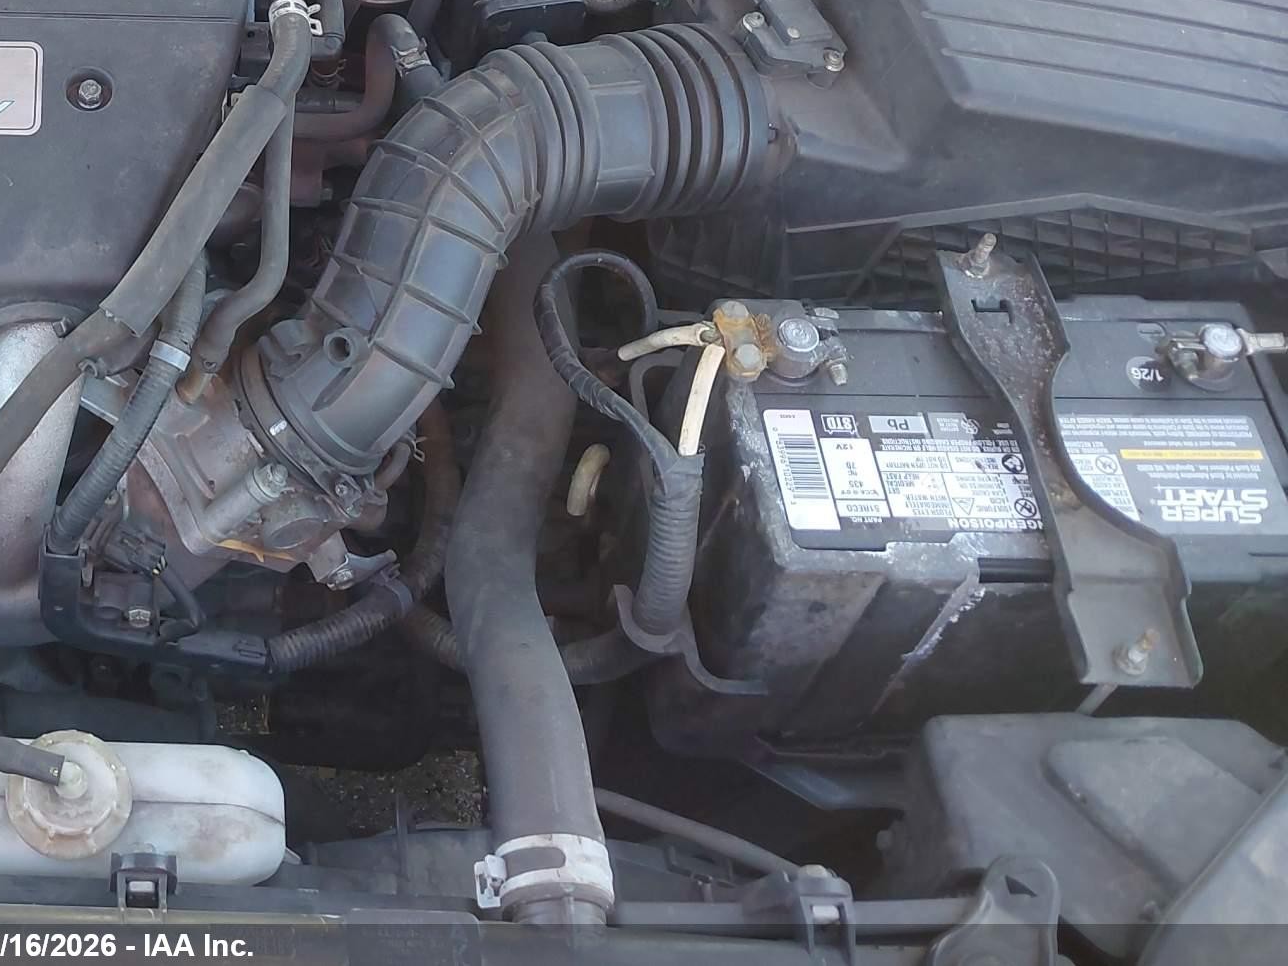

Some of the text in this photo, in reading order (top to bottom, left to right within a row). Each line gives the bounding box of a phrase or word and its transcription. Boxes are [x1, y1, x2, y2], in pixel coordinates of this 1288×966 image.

[1130, 367, 1164, 382] 1/26
[886, 418, 909, 431] Pb
[1157, 489, 1269, 509] START
[1161, 506, 1263, 524] SUPER
